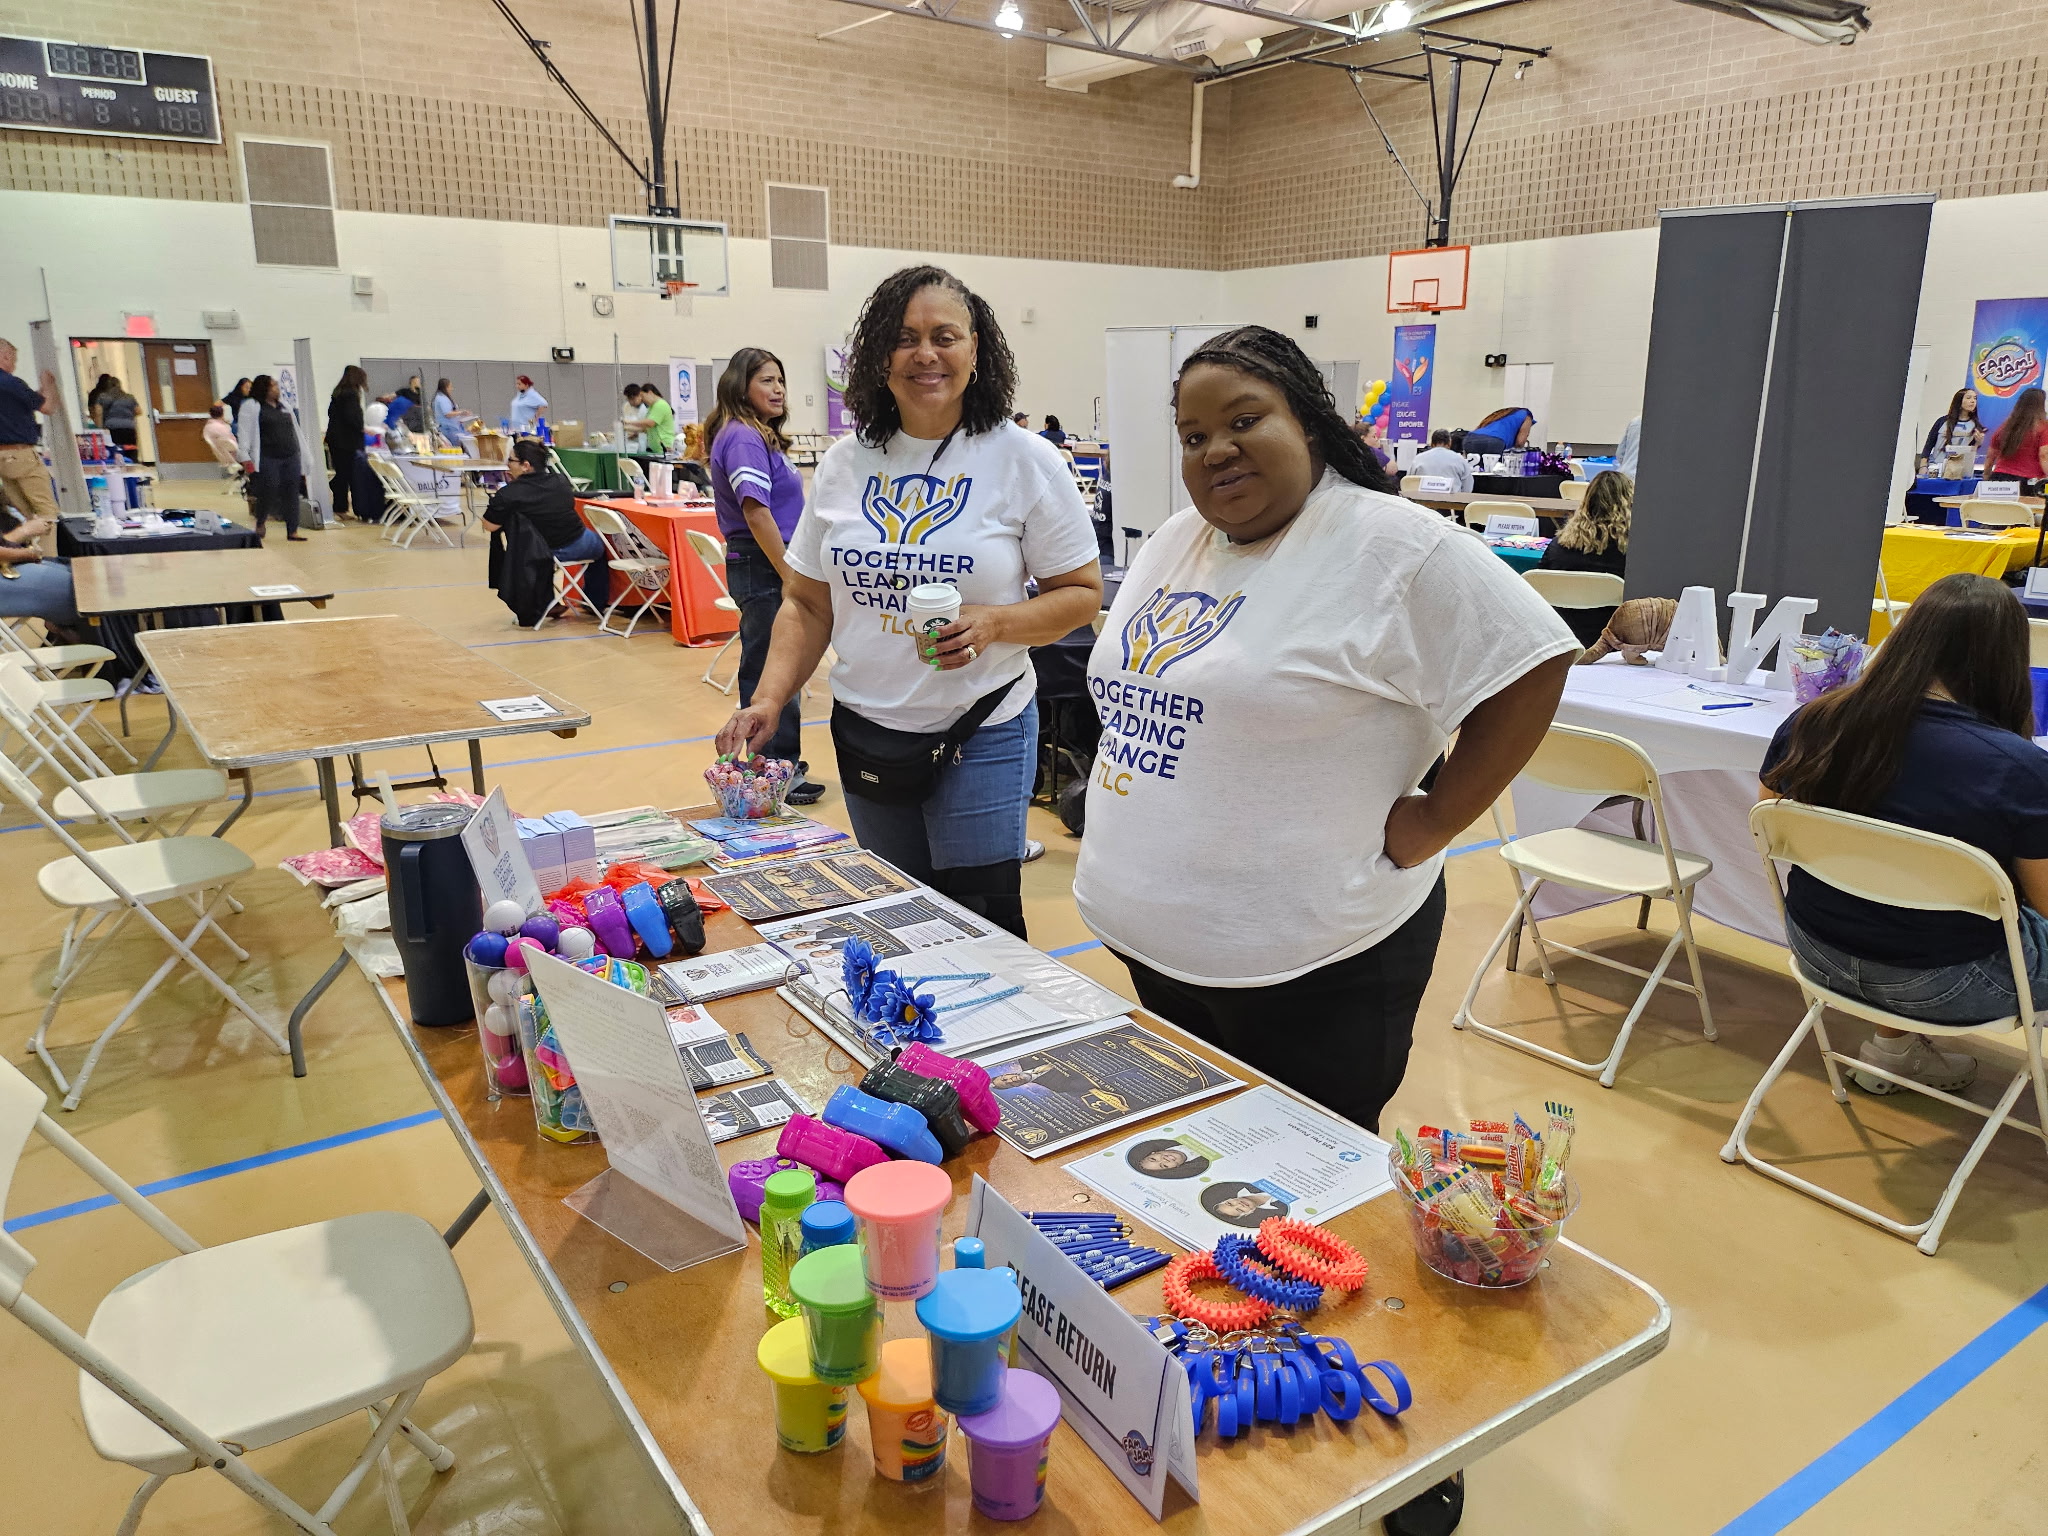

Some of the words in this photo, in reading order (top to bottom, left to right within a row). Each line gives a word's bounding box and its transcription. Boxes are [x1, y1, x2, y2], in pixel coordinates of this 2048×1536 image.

[81, 86, 117, 100] PERIOD
[154, 87, 198, 104] GUEST
[1978, 354, 2010, 376] FAM
[1996, 351, 2034, 378] JAM!
[831, 547, 974, 574] TOGETHER
[1100, 706, 1186, 750] EADING
[1097, 760, 1133, 796] TLC
[1088, 1099, 1108, 1108] 3
[1127, 1181, 1146, 1190] Well
[1141, 1188, 1170, 1204] Yourself
[1165, 1202, 1191, 1217] Loving
[1056, 1311, 1117, 1400] RETURN
[1123, 1437, 1142, 1451] FAM
[1133, 1445, 1154, 1464] JAM!
